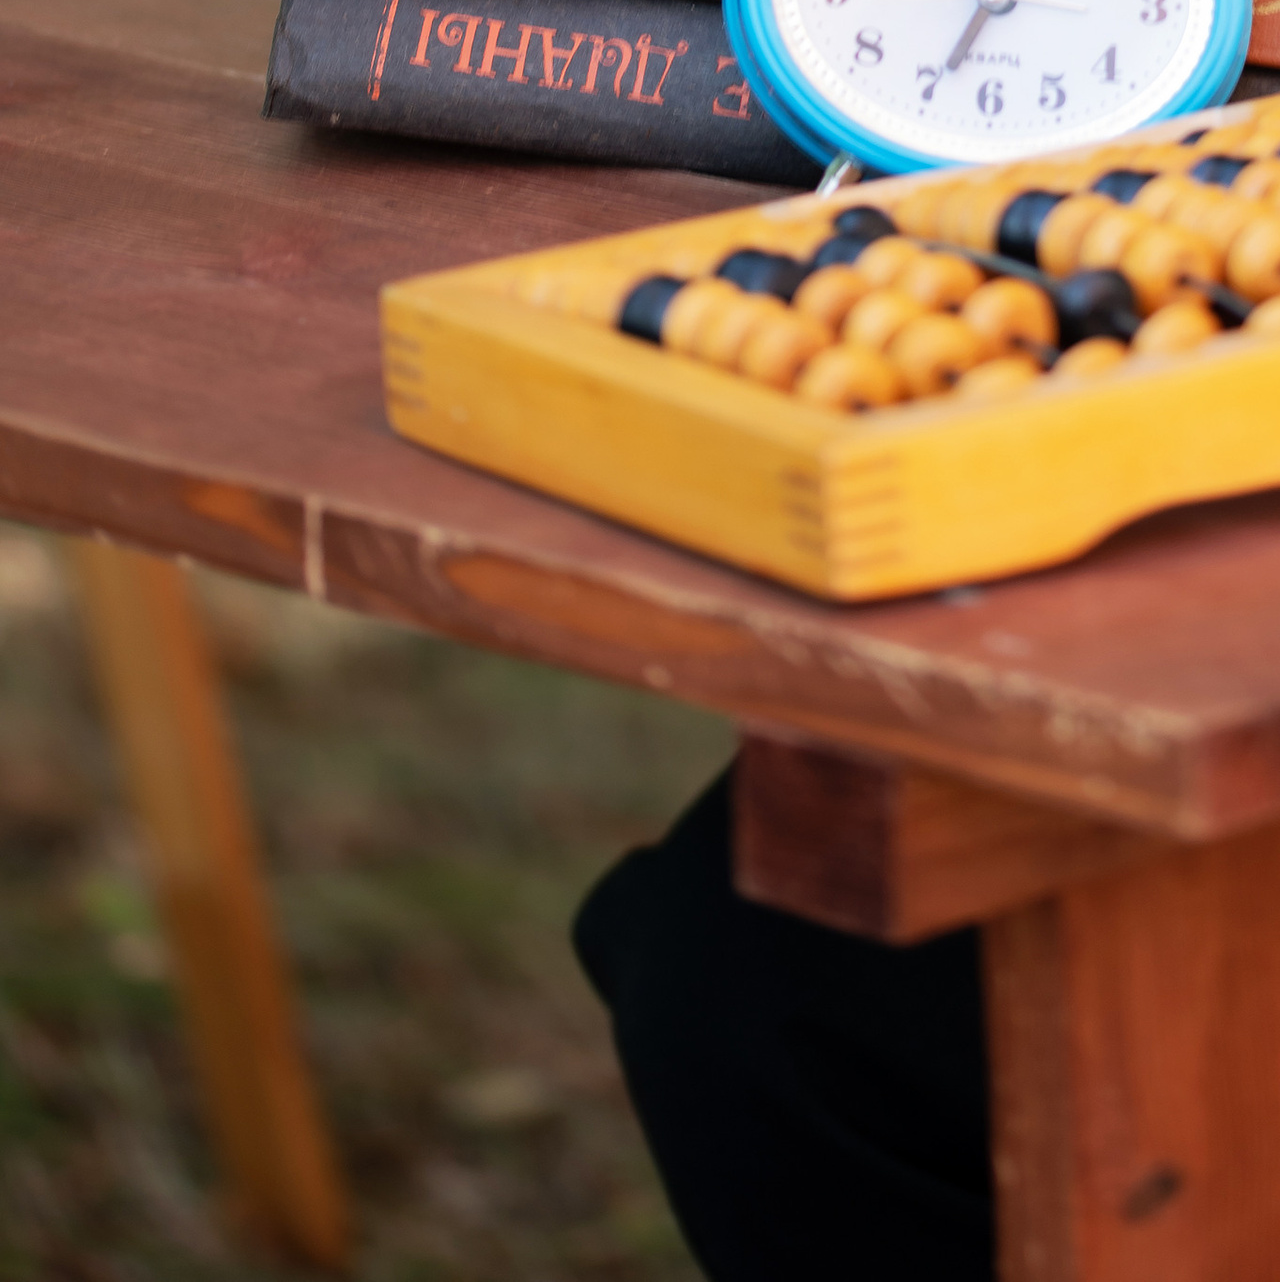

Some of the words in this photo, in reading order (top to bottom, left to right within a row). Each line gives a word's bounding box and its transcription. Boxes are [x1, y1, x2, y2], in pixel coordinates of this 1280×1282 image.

[409, 8, 689, 106] ДИАНЫ
[854, 27, 884, 67] 8
[1092, 43, 1122, 85] 4
[916, 63, 943, 102] 7
[977, 77, 1004, 118] 6
[1038, 72, 1067, 113] 5
